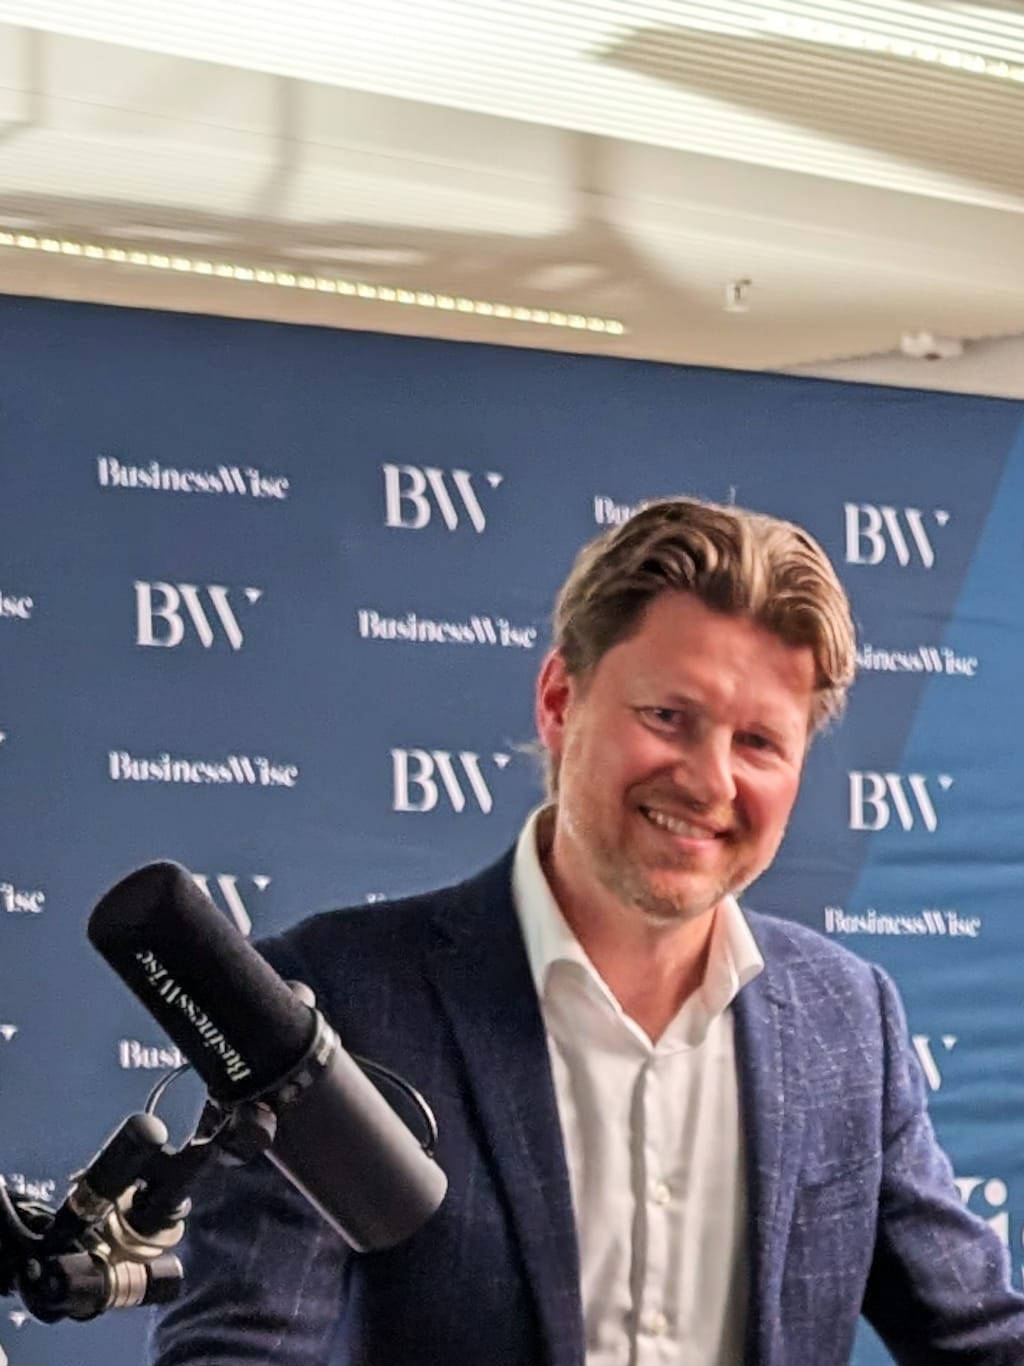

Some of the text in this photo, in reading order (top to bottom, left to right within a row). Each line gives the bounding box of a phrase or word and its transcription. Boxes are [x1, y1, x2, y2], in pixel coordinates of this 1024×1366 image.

[99, 457, 290, 499] BusinessWise
[383, 464, 503, 533] BW
[845, 503, 949, 568] BW
[134, 581, 261, 650] BW
[358, 610, 537, 649] BusinessWise
[109, 751, 298, 787] BusinessWise
[391, 748, 510, 814] BW
[849, 771, 953, 832] BW
[824, 908, 981, 938] BusinessWise
[136, 950, 251, 1082] BusinessWise
